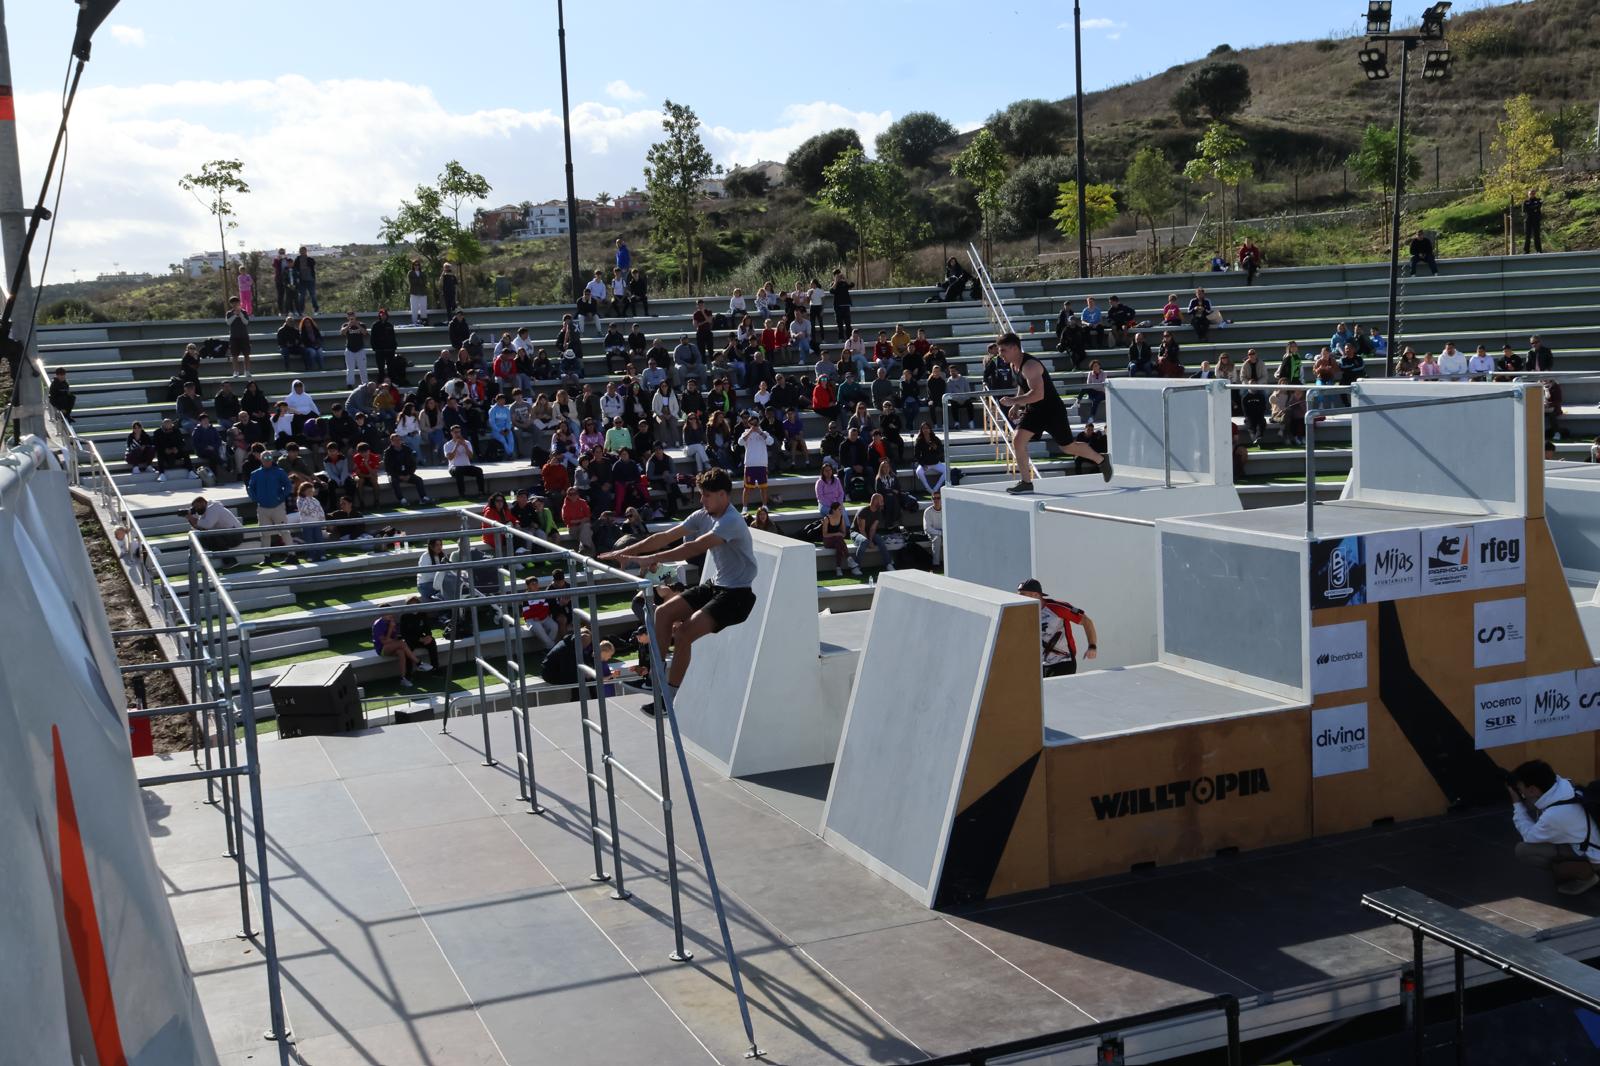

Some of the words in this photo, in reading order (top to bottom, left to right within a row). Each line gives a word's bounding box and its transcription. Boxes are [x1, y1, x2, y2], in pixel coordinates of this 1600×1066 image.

[1480, 537, 1520, 563] rfeg
[1374, 548, 1414, 578] Mijas
[1428, 565, 1469, 575] PARKOUR
[1480, 696, 1522, 710] vocento
[1534, 689, 1571, 716] Mijas
[1485, 714, 1516, 729] SUR
[1316, 725, 1366, 748] divina
[1090, 767, 1270, 821] WALLTOPIA
